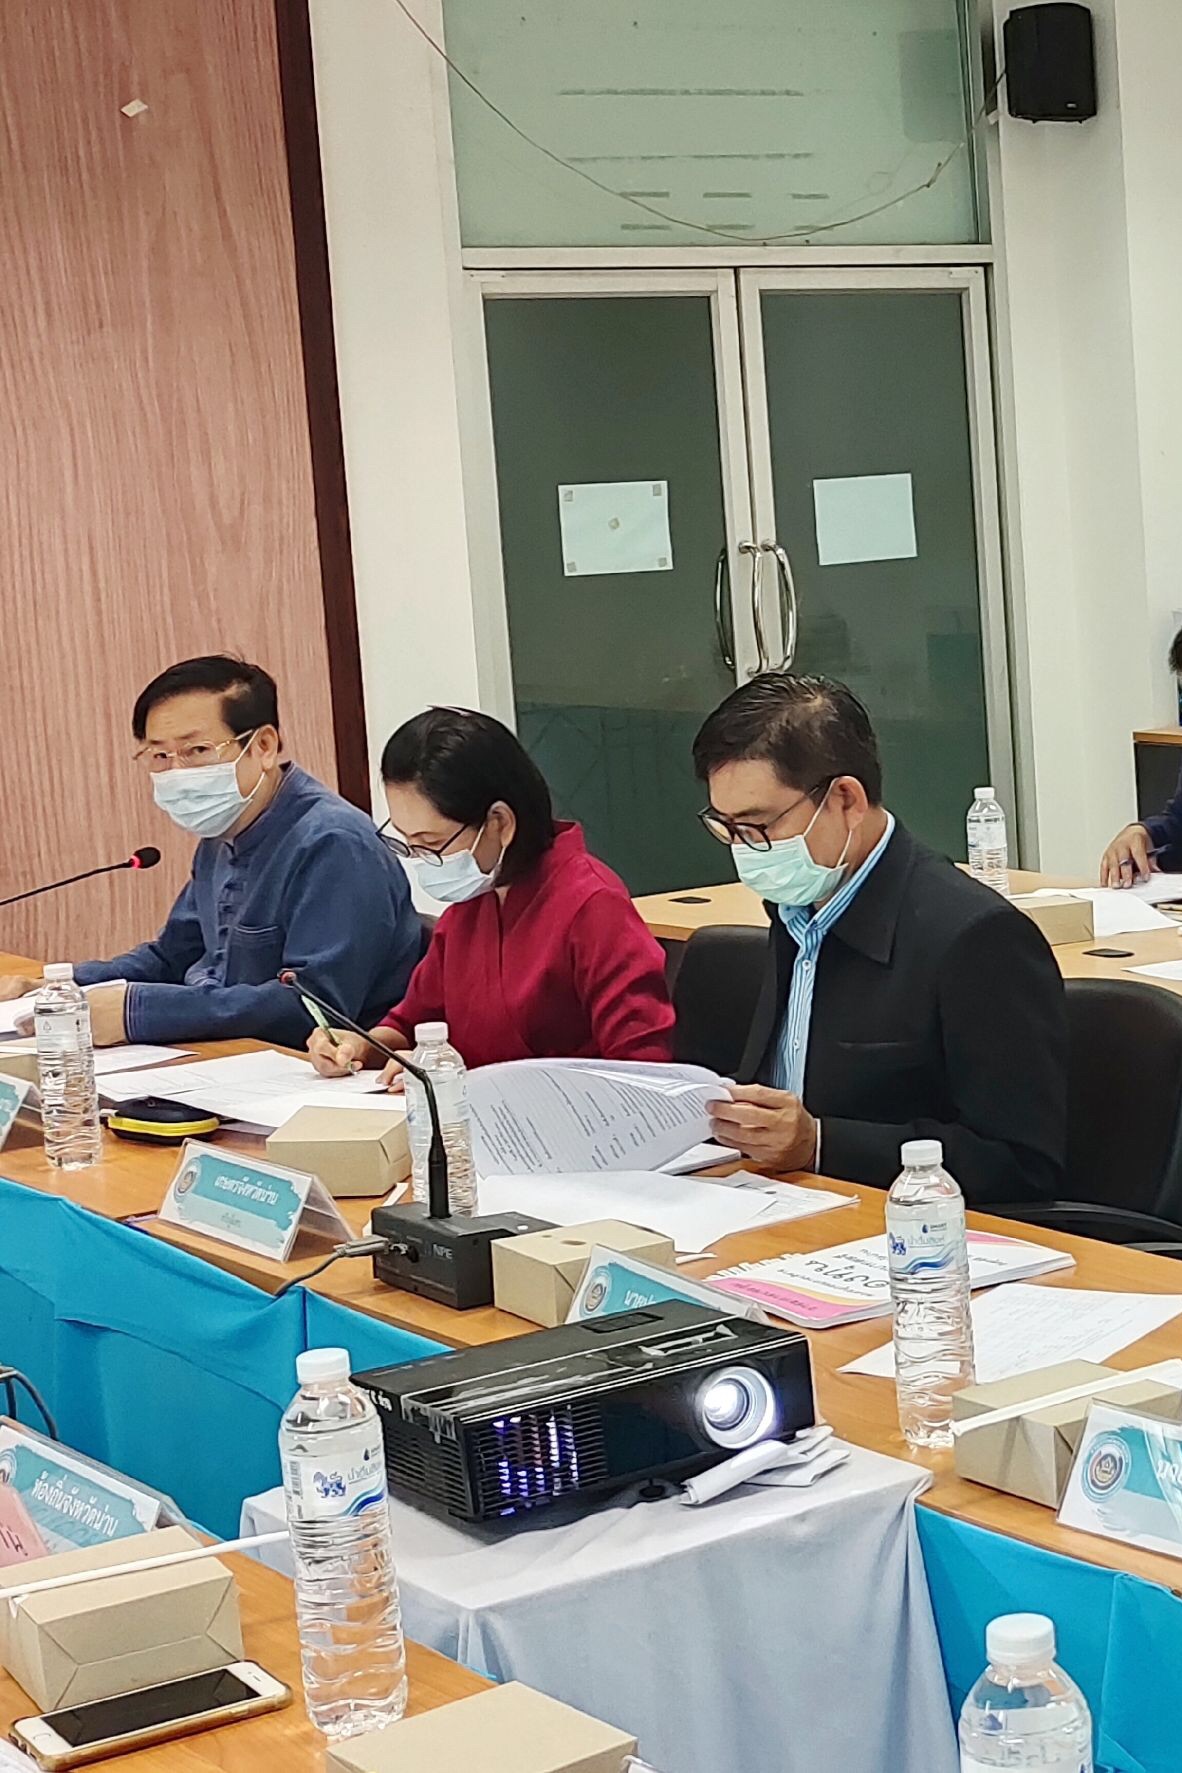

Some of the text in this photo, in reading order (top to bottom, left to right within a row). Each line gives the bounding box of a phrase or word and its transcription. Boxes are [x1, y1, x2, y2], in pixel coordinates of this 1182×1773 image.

[31, 1470, 119, 1537] ท้องถิ่นจังหวัดน่าน
